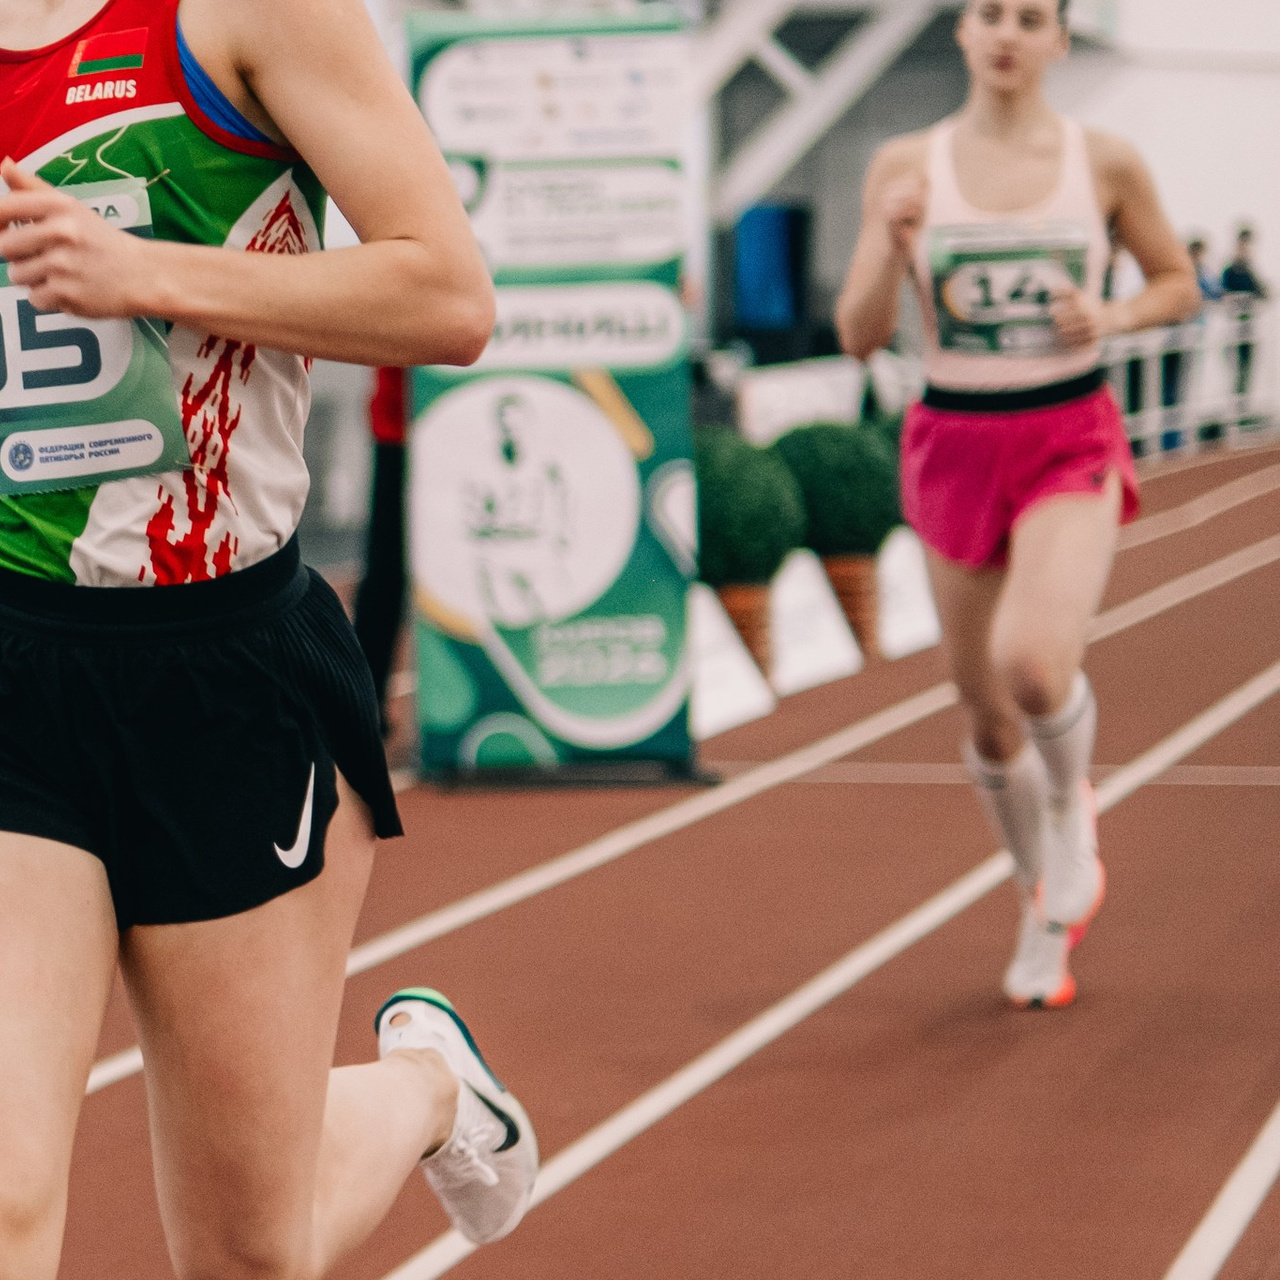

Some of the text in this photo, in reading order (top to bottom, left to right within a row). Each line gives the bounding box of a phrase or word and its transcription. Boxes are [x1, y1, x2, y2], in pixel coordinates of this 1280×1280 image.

[65, 79, 137, 105] BELARUS
[38, 433, 153, 454] ФЕДЕРАЦИЯ СОВРЕМЕННОГО
[38, 448, 120, 464] ПЯТИБОРЬЯ РОССИИ
